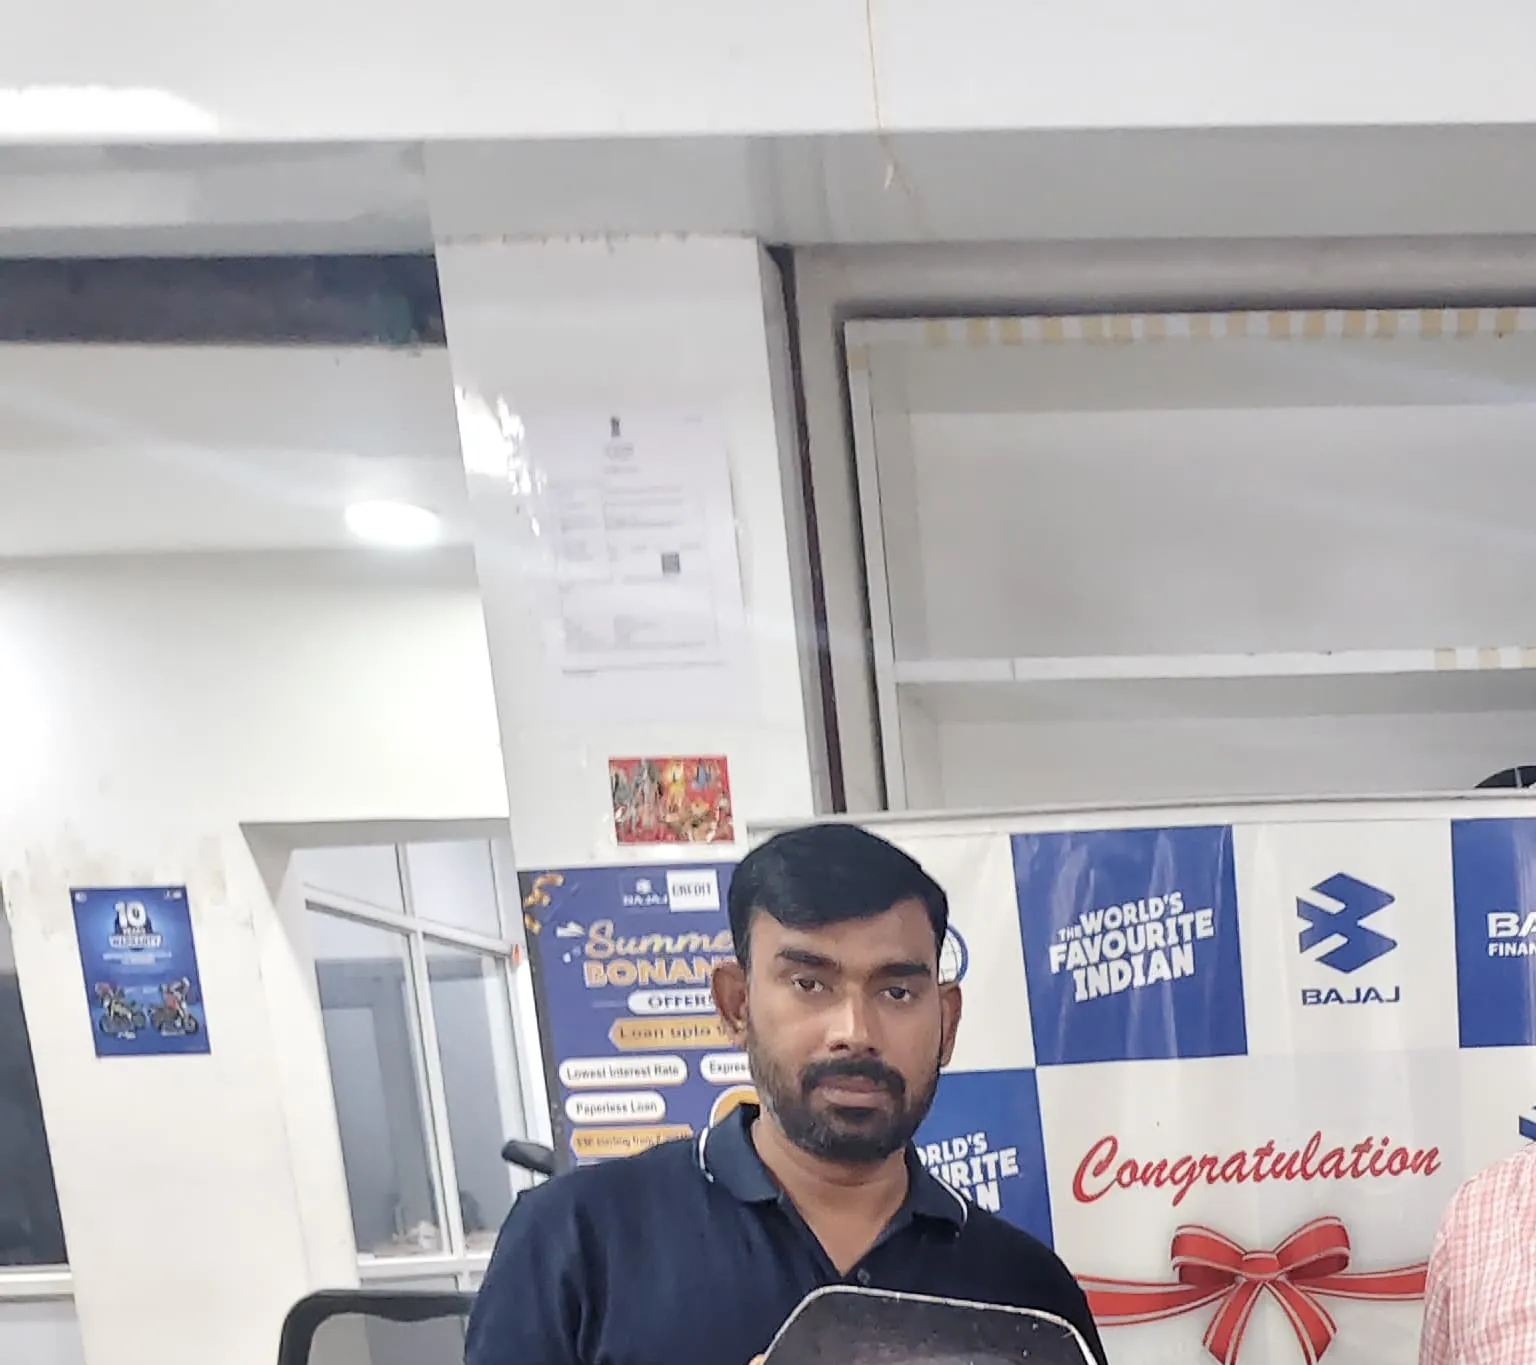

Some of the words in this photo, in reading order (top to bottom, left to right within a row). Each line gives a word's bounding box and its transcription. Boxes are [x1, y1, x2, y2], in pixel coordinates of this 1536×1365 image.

[1058, 925, 1082, 942] THE
[1080, 892, 1184, 936] WORLD'S
[584, 918, 734, 958] Summe
[1049, 908, 1214, 975] FAVOURITE
[1073, 943, 1195, 1003] INDIAN
[1301, 985, 1400, 1006] BAJAJ
[567, 1065, 607, 1080] Lowest
[609, 1063, 651, 1078] Interest
[654, 1063, 680, 1076] Rate
[709, 1060, 750, 1074] Expres
[576, 1102, 628, 1117] Paperless
[1072, 1130, 1442, 1207] Congratulation
